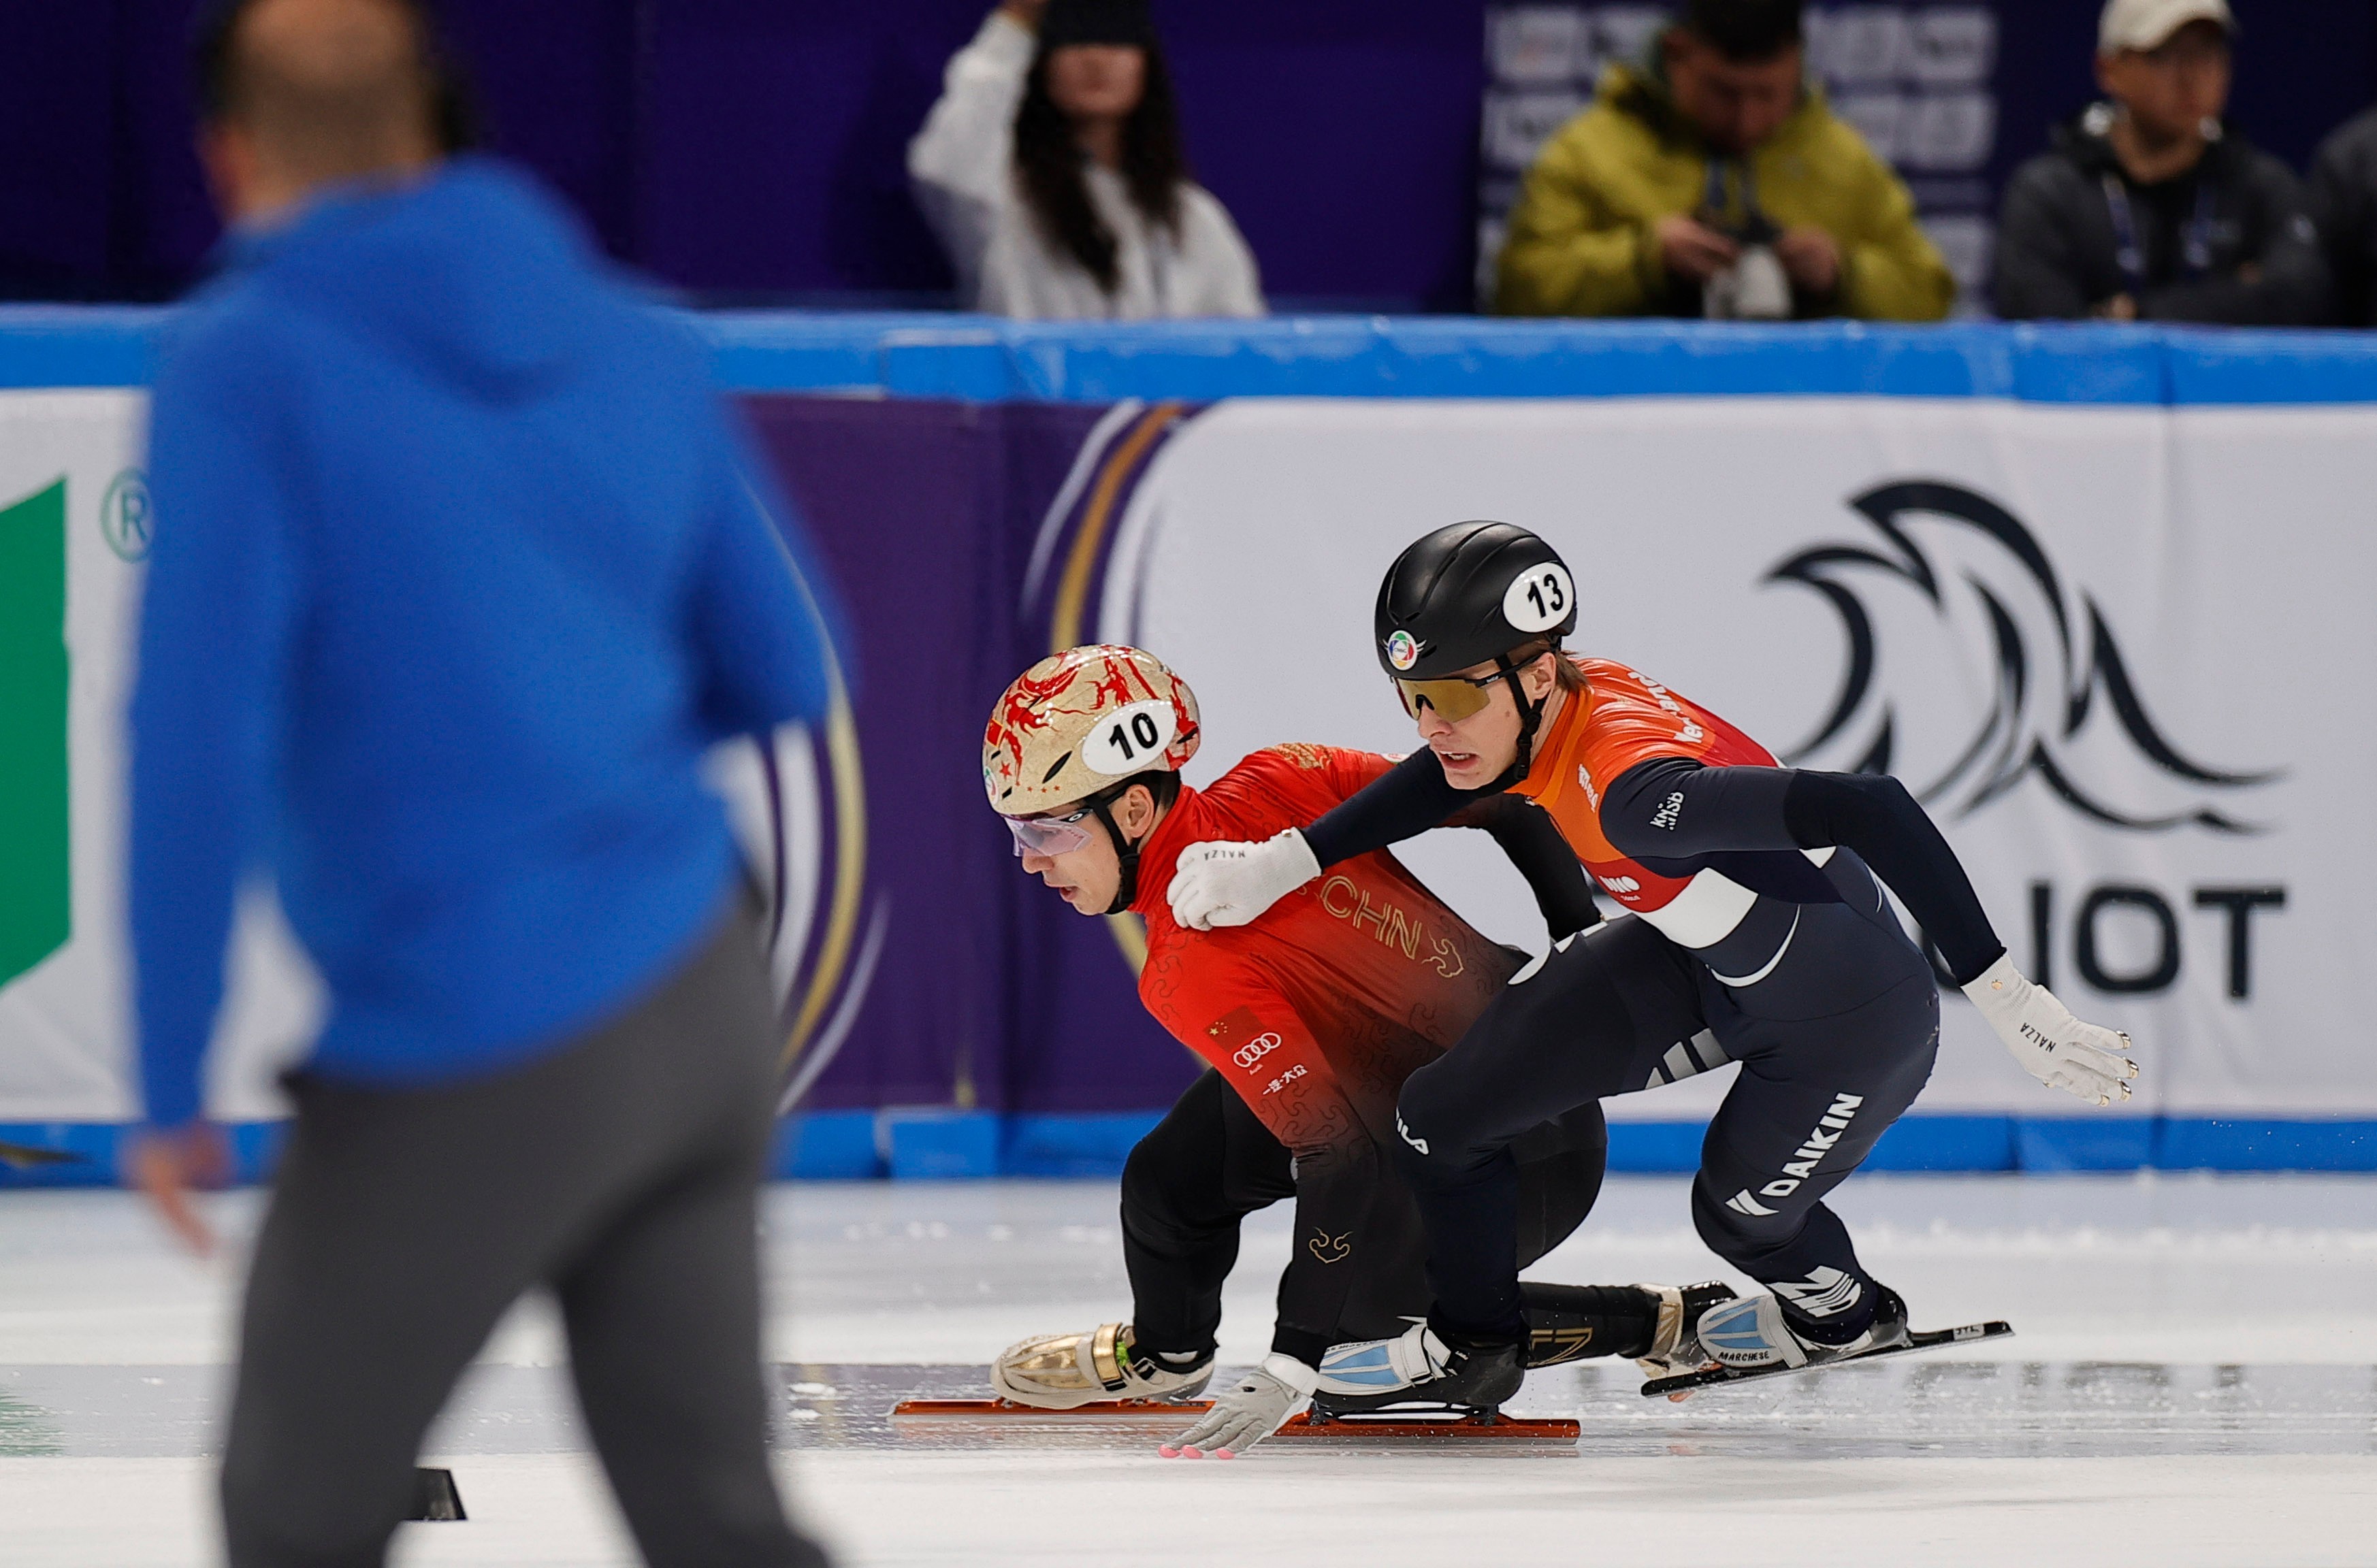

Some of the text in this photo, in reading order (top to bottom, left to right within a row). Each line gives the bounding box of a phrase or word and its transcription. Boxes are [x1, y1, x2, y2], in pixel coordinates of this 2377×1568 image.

[1527, 574, 1564, 619] 13
[1108, 713, 1159, 761] 10
[1319, 875, 1423, 960] CHN
[1918, 882, 2285, 998] IOT
[2020, 1022, 2057, 1054] NALZA
[1395, 1105, 1429, 1156] ILA
[1758, 1092, 1864, 1197] DAIKIN
[1718, 1350, 1770, 1362] MARCHESE
